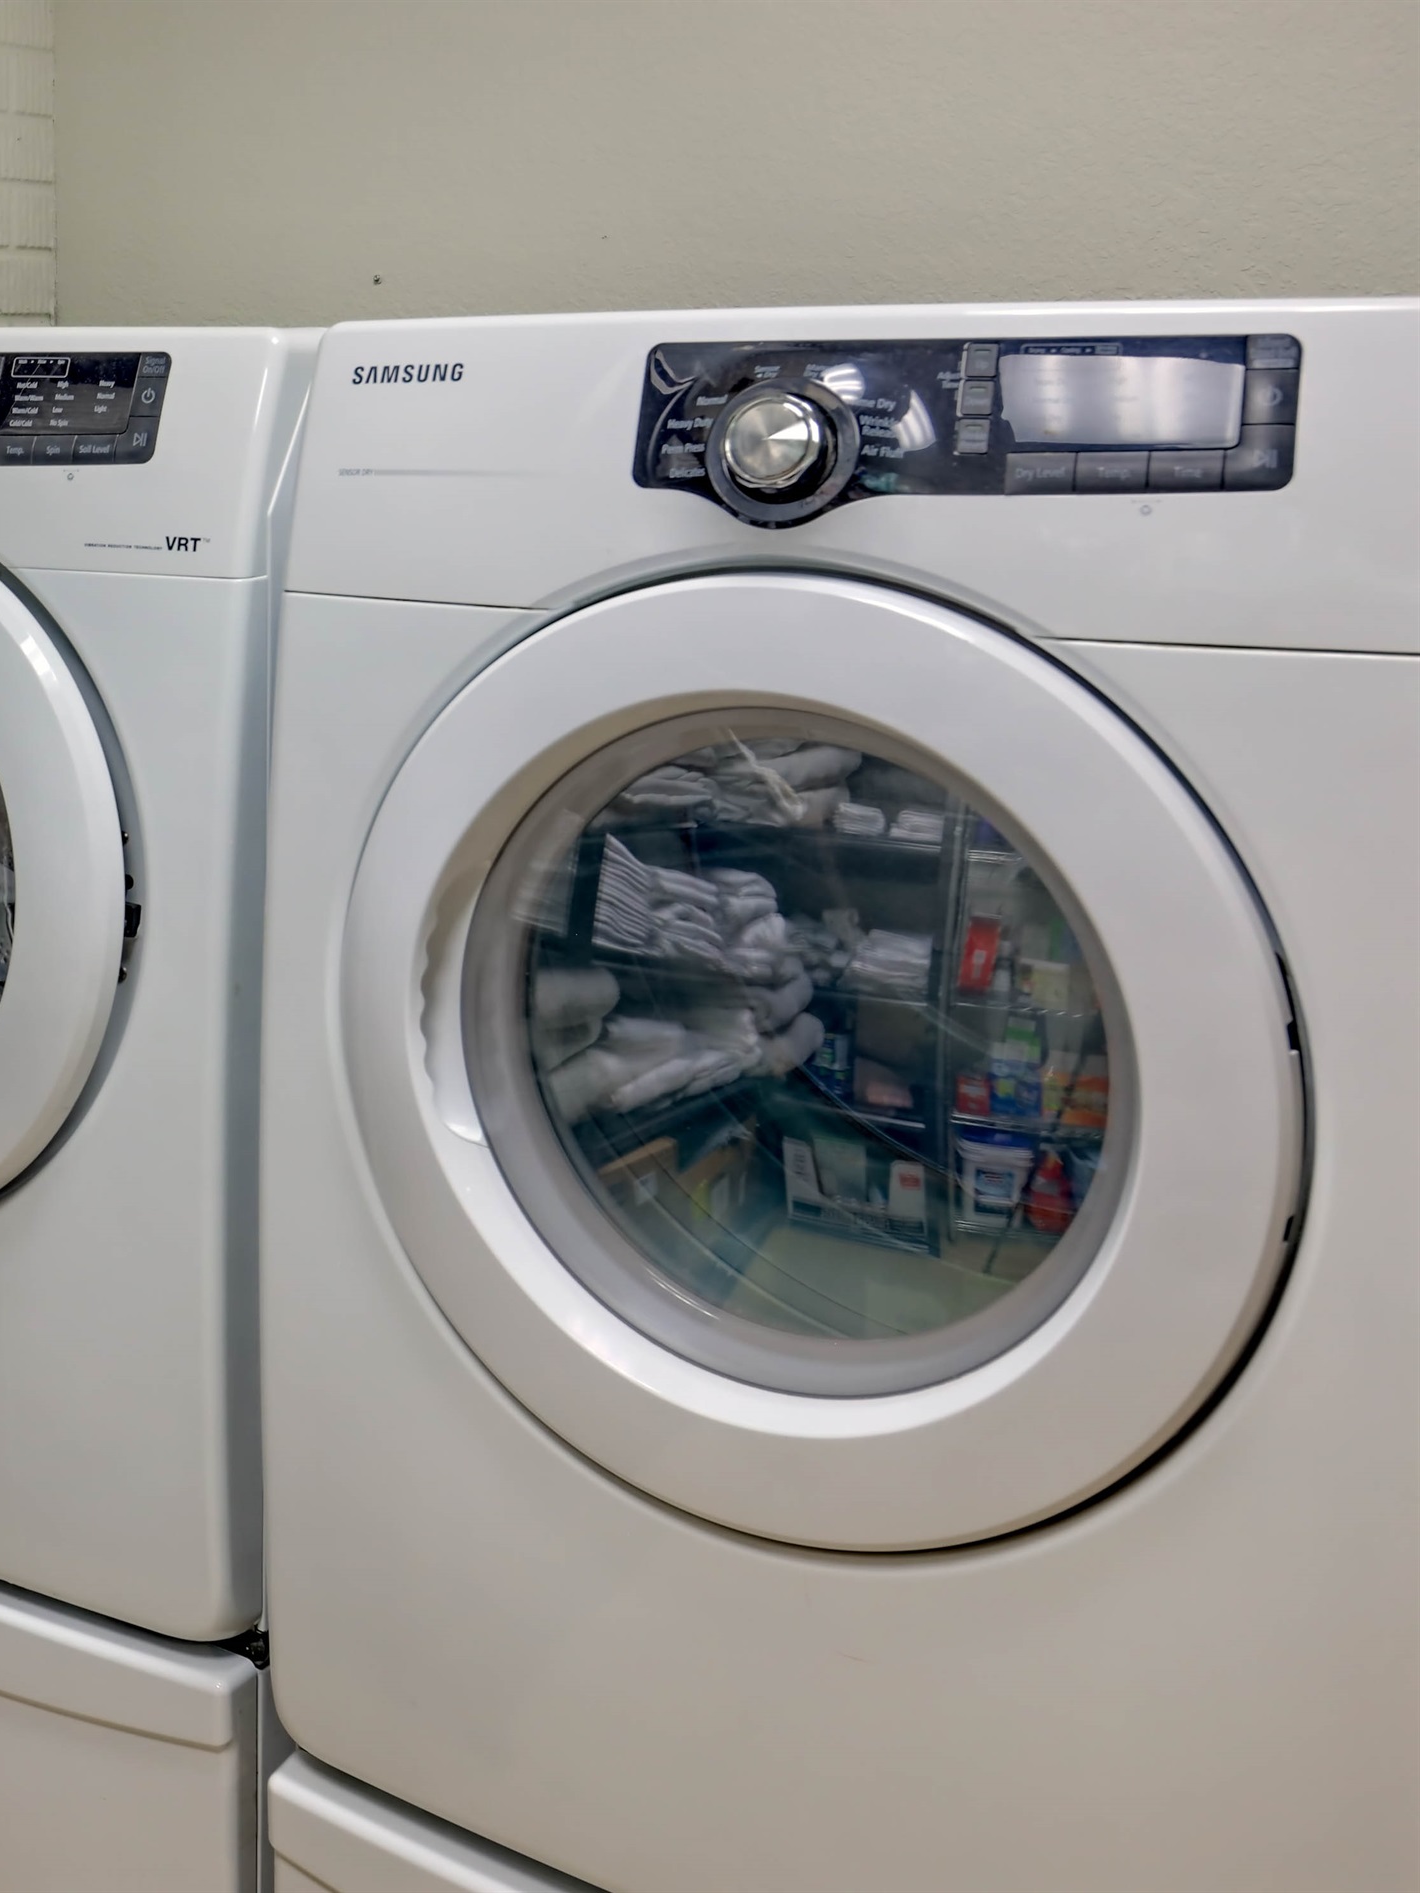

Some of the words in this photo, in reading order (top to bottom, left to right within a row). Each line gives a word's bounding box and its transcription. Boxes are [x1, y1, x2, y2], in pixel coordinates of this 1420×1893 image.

[145, 356, 166, 366] Signal
[142, 365, 165, 374] On/Off
[352, 362, 464, 385] SAMSUNG
[696, 394, 729, 406] Normal
[876, 398, 897, 412] Dry
[93, 404, 108, 413] Light
[667, 418, 694, 431] Heavy
[6, 446, 25, 456] Temp.
[46, 446, 61, 455] Spin
[79, 445, 92, 453] Soil
[93, 445, 110, 454] Level
[861, 444, 879, 457] Air
[362, 468, 374, 477] DRY
[1015, 467, 1034, 481] Dry
[1036, 467, 1065, 479] Level
[165, 536, 201, 552] VRT
